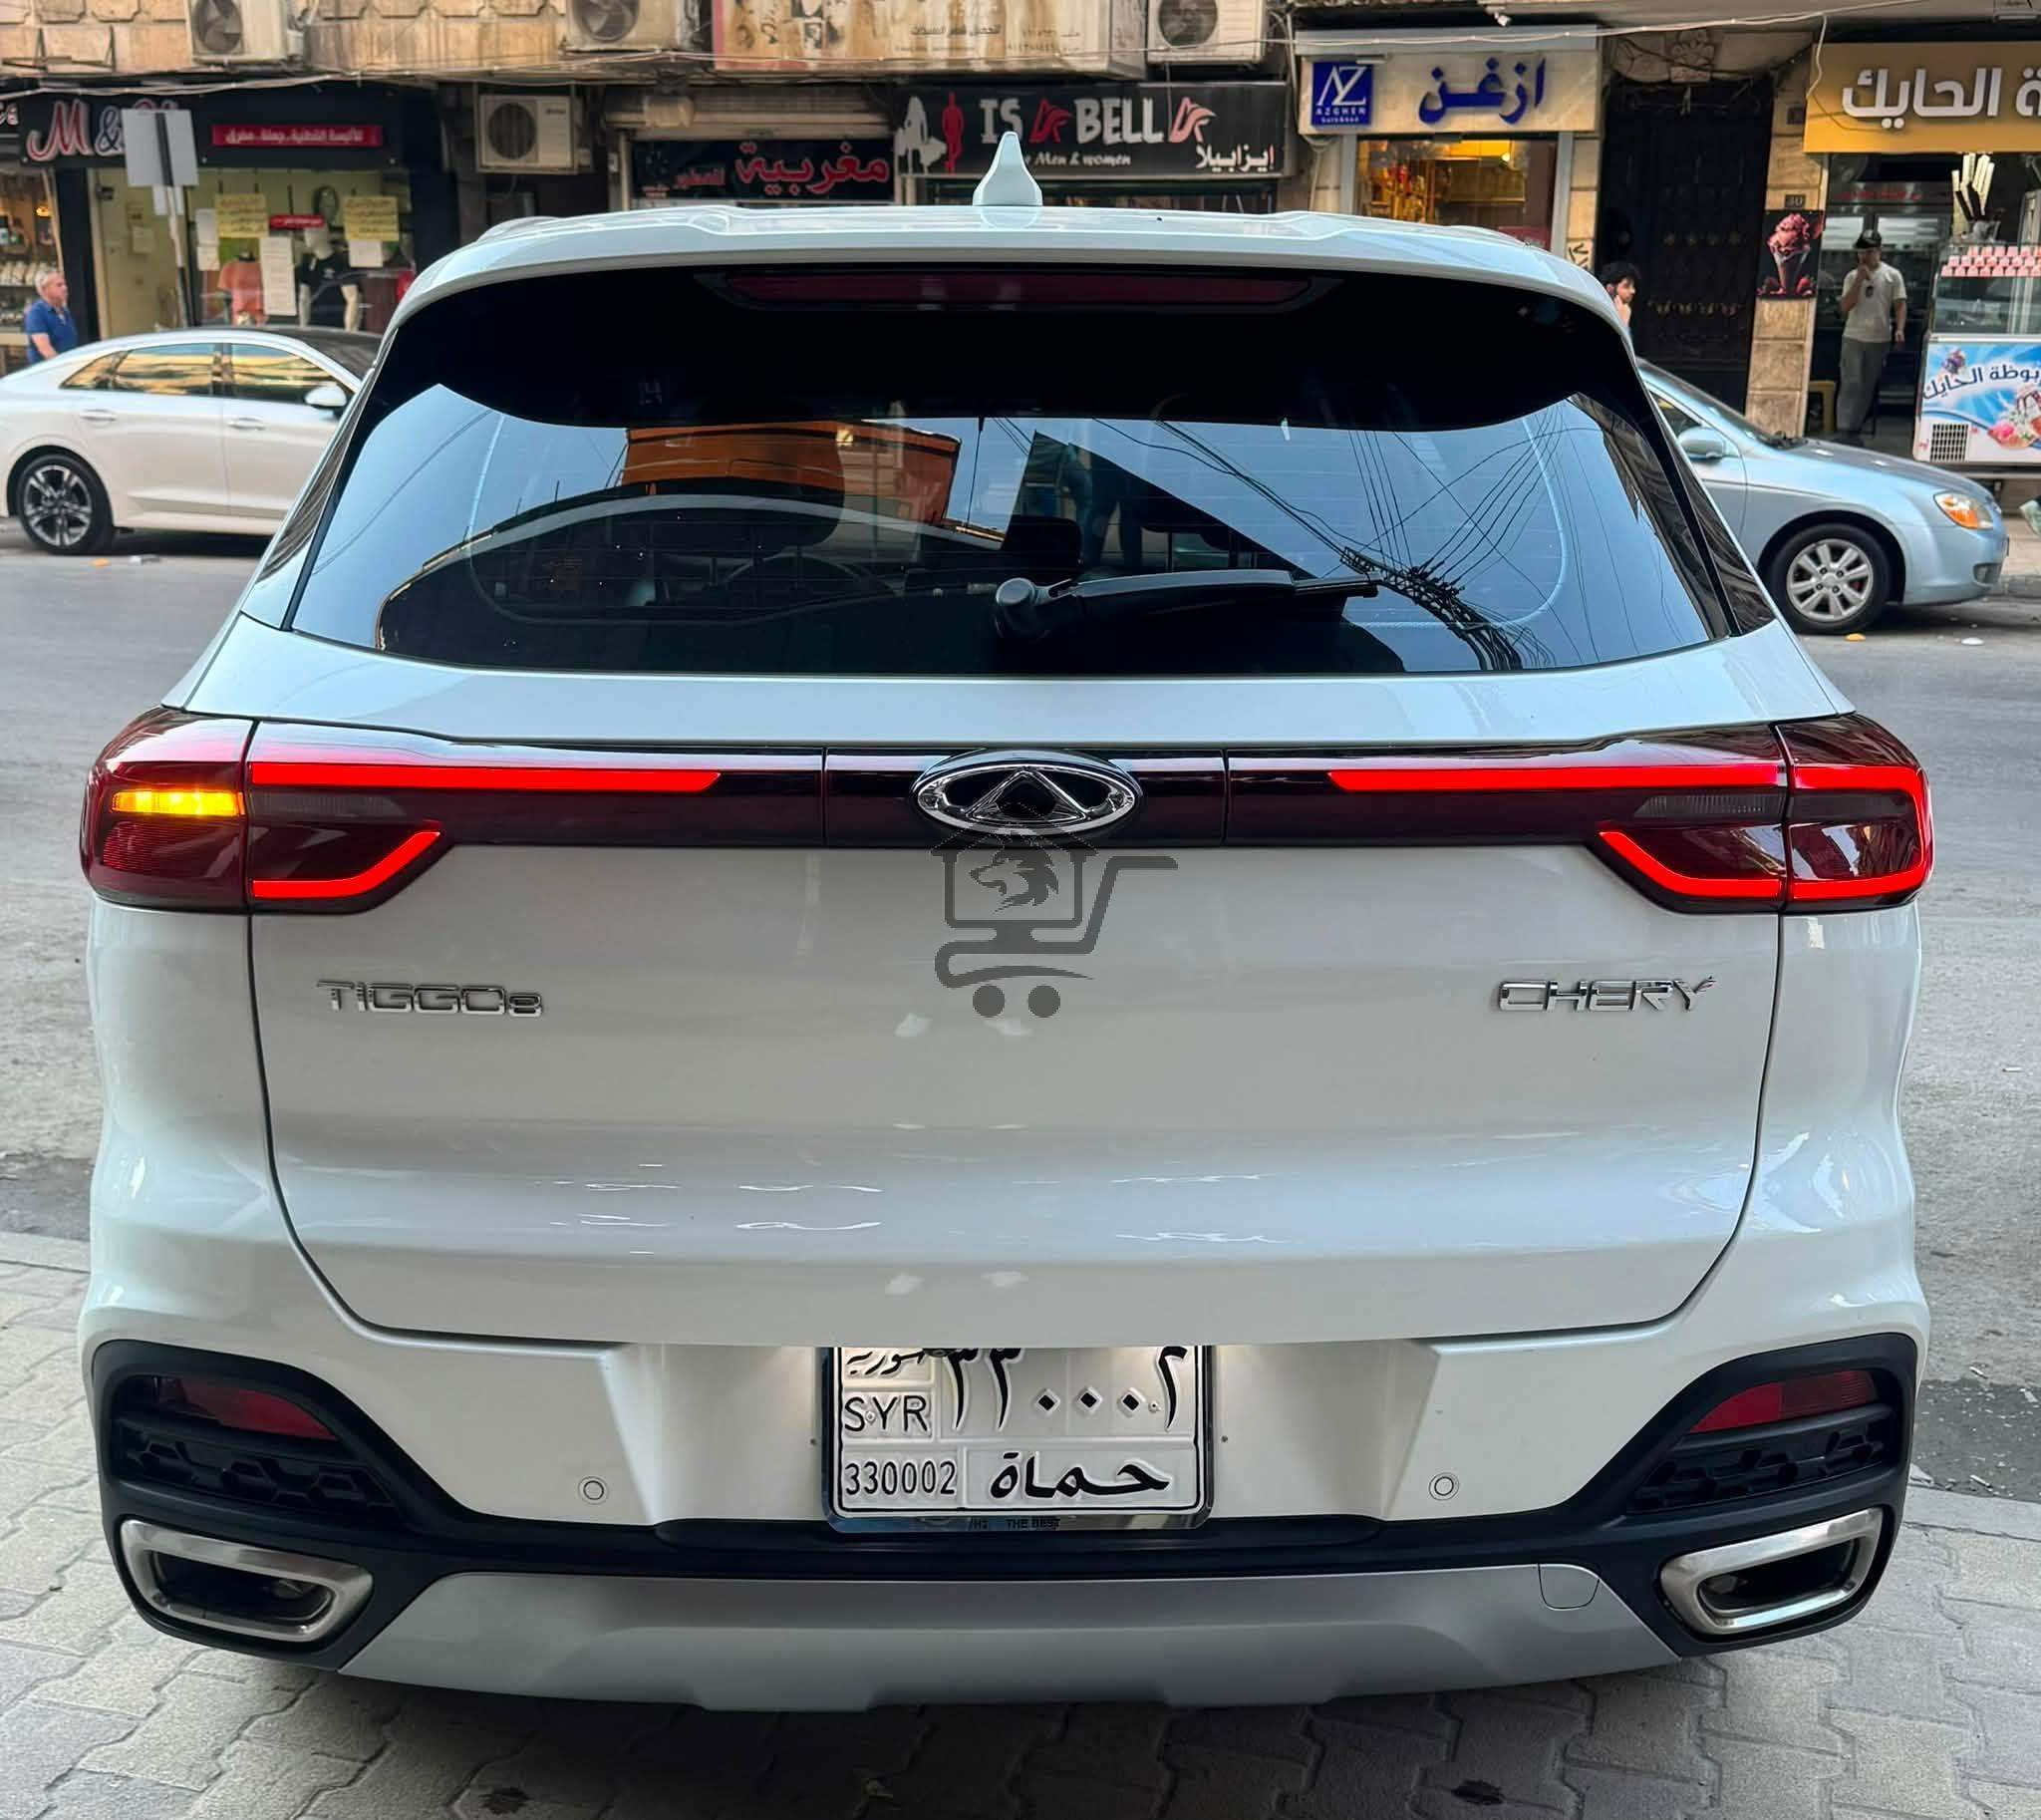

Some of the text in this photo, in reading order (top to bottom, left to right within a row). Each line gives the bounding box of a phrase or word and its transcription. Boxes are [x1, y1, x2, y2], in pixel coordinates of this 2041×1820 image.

[1843, 68, 2002, 129] الحايك
[734, 142, 890, 195] مغربية
[1500, 976, 1716, 1011] CHERY
[844, 1395, 928, 1432] SYR
[845, 1460, 956, 1496] 330002
[990, 1451, 1170, 1499] حماة
